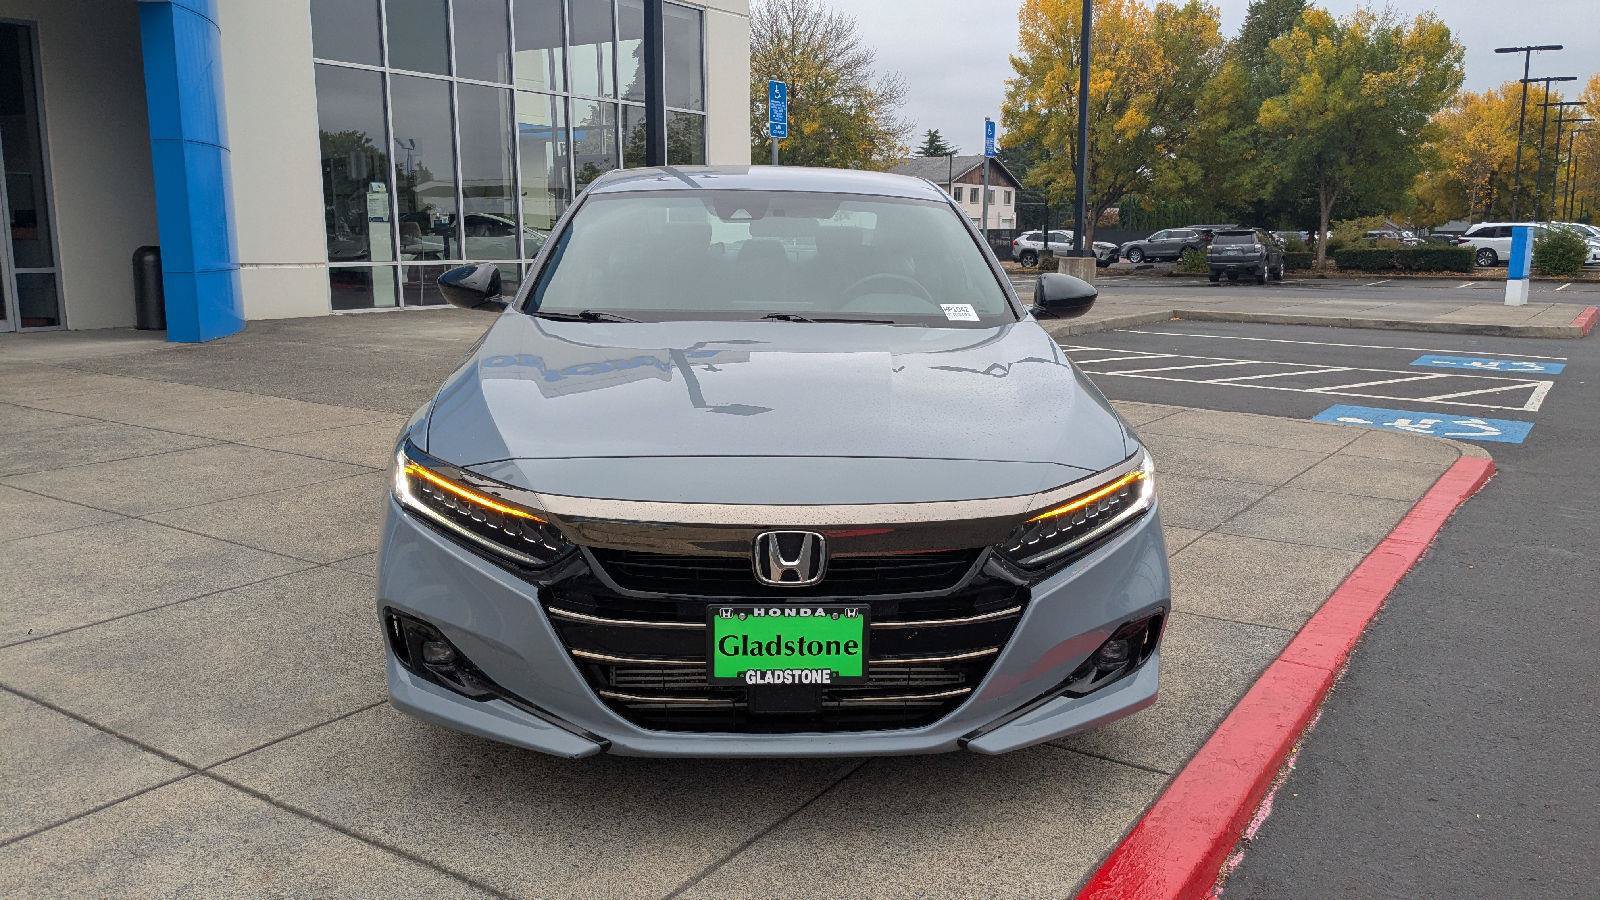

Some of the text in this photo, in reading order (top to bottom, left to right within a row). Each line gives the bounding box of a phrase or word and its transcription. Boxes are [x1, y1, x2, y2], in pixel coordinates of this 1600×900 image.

[753, 607, 826, 617] HONDA
[718, 633, 859, 657] Gladstone
[745, 669, 831, 684] GLADSTONE
